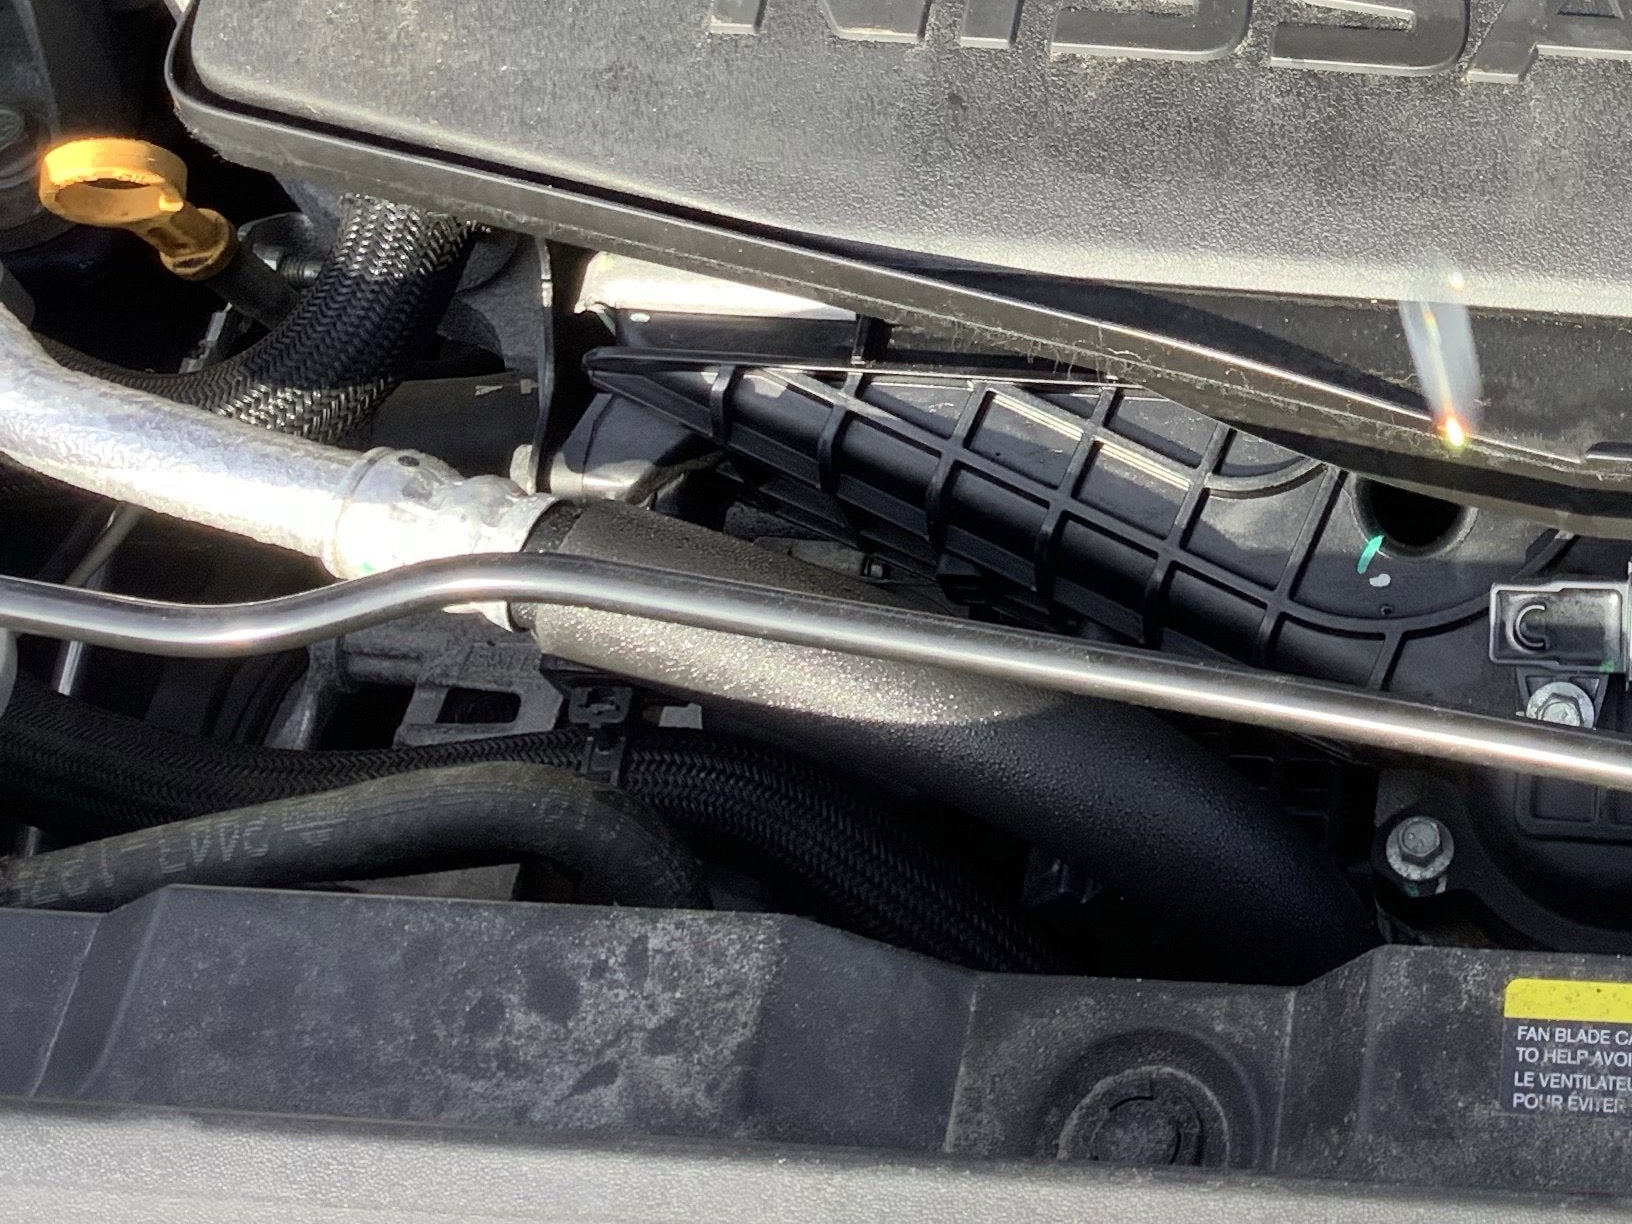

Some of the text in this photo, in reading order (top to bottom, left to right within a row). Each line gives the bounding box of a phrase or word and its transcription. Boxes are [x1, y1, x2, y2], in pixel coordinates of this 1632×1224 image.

[1517, 1026, 1550, 1042] FAN
[1555, 1028, 1611, 1045] BLADE
[1516, 1047, 1539, 1063] TO
[1544, 1049, 1591, 1065] HELP
[1514, 1072, 1535, 1087] LE
[1512, 1093, 1563, 1110] POUR
[1567, 1094, 1626, 1114] ÉVITER
